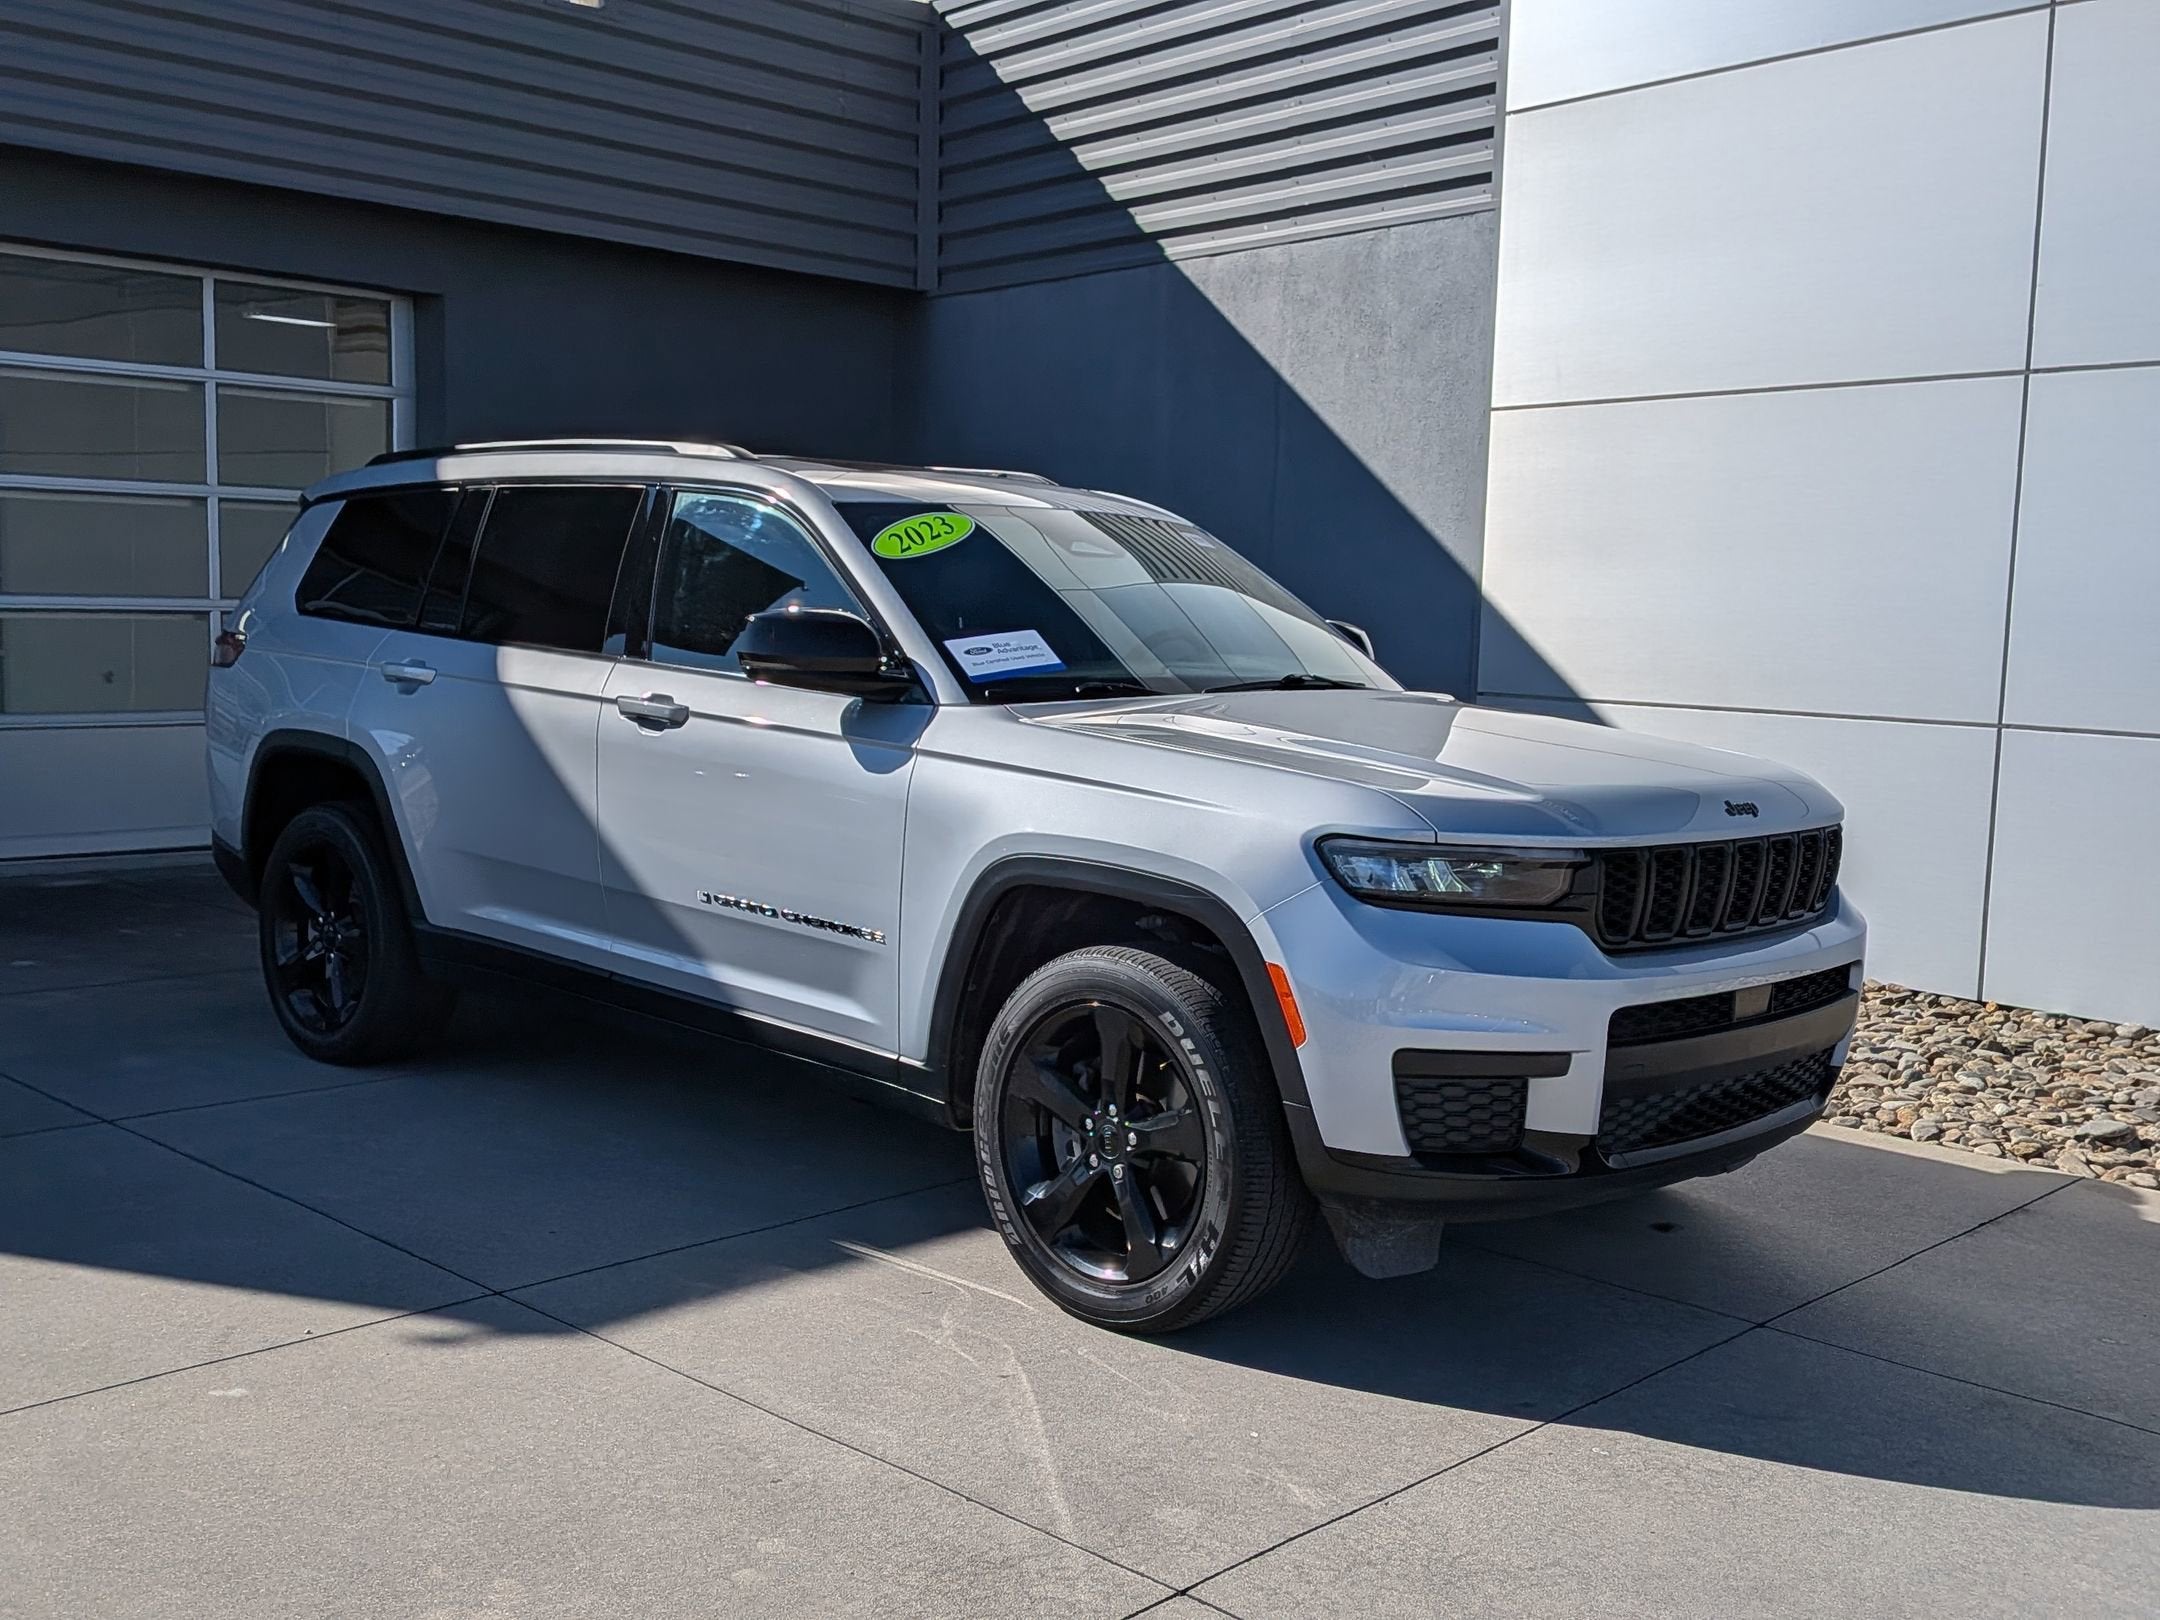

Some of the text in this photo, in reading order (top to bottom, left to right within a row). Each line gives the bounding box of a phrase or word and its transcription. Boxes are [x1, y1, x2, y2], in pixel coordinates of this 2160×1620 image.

[888, 516, 954, 553] 2023
[997, 644, 1040, 655] Advantage
[1723, 800, 1760, 818] Jeep
